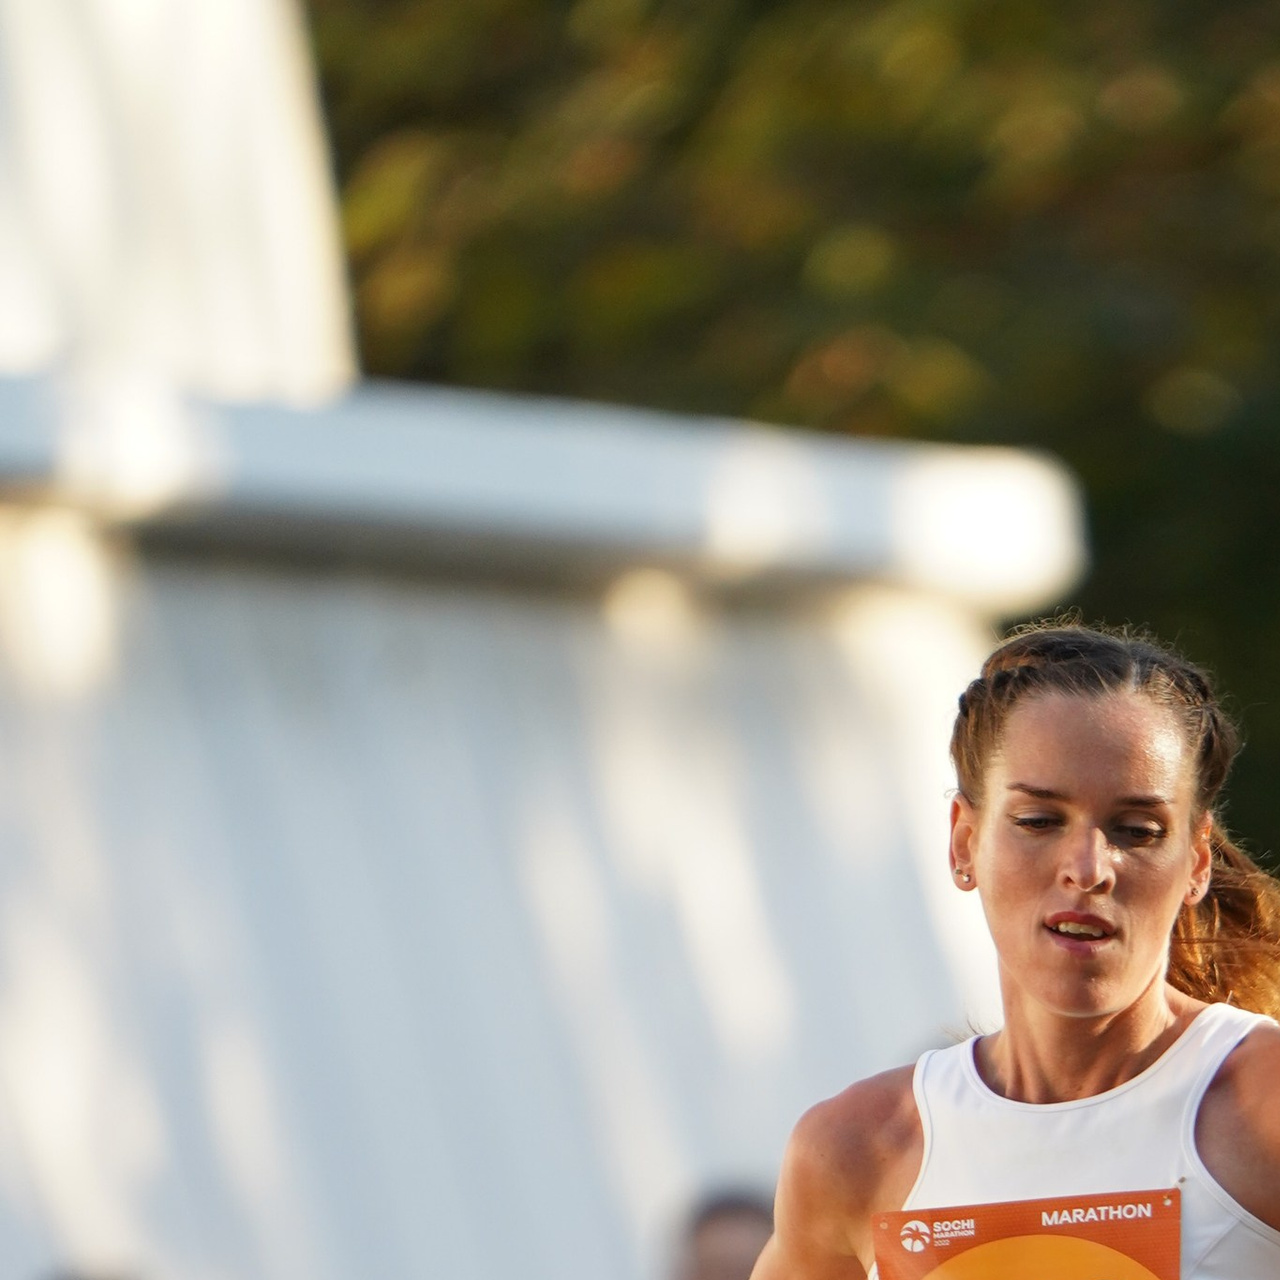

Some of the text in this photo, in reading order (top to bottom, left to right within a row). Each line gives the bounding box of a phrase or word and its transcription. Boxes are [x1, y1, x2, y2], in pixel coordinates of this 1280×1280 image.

[1041, 1203, 1152, 1226] MARATHON
[933, 1219, 975, 1232] SOCHI
[933, 1229, 975, 1239] MARATHON
